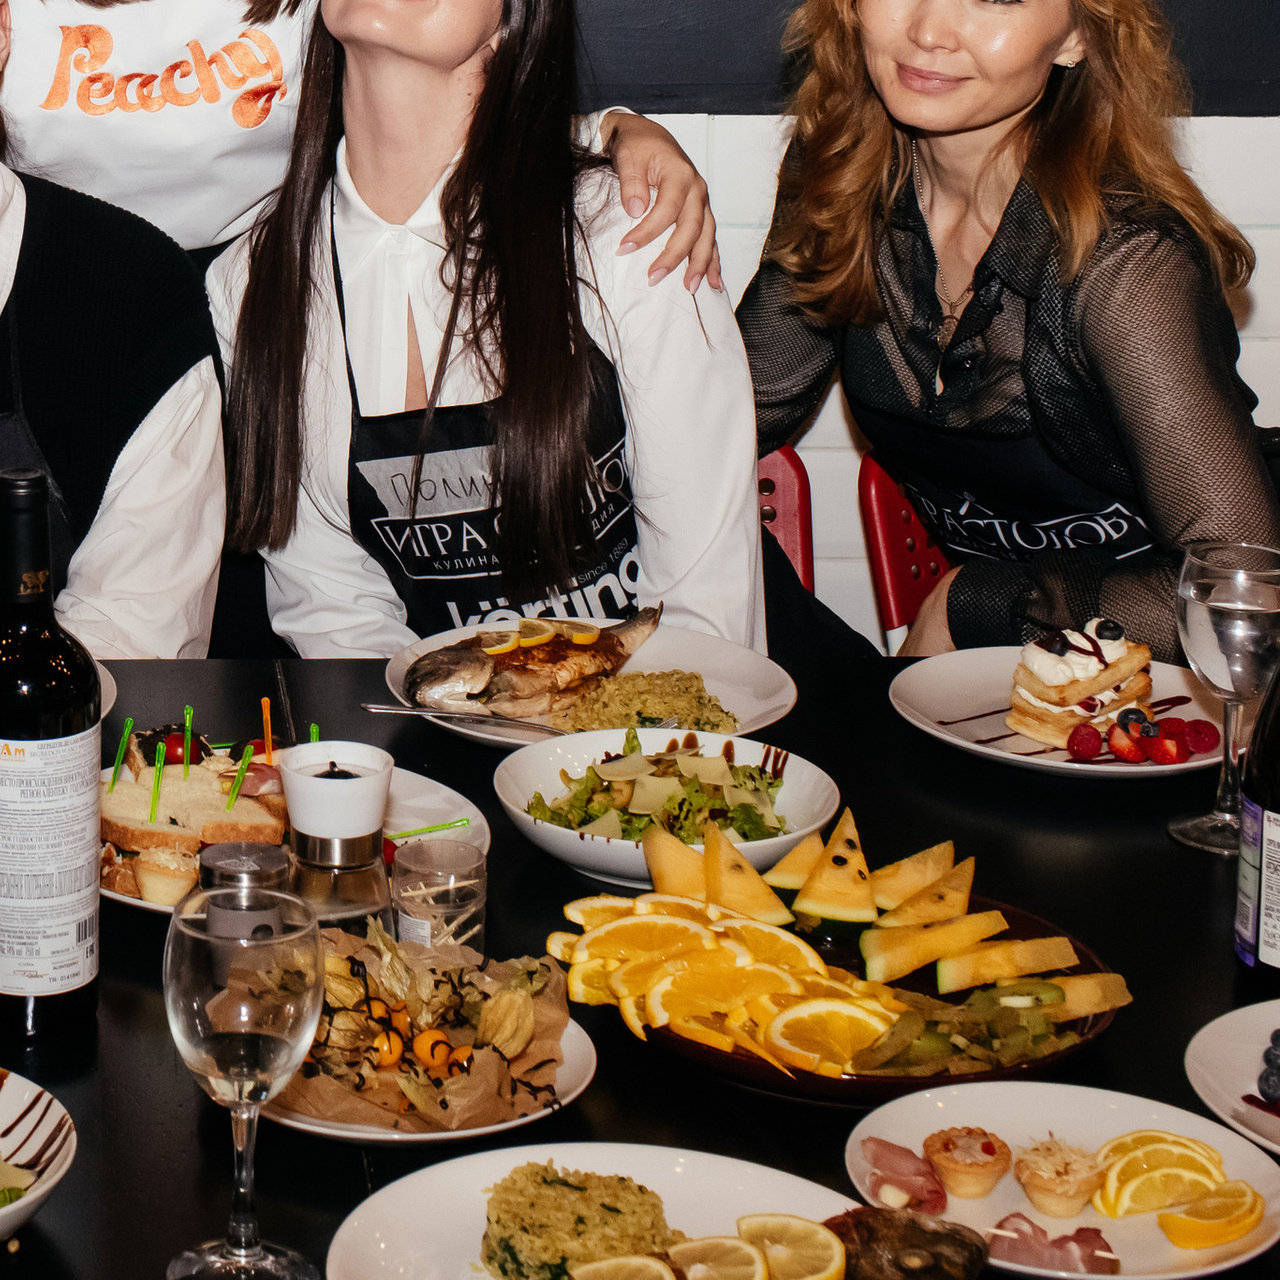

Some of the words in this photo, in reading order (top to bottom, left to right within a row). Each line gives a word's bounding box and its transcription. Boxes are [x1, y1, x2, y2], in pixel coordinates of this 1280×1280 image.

[38, 23, 288, 129] Peachy
[383, 521, 488, 558] ИГРА
[577, 563, 608, 584] since
[608, 537, 629, 564] 1889
